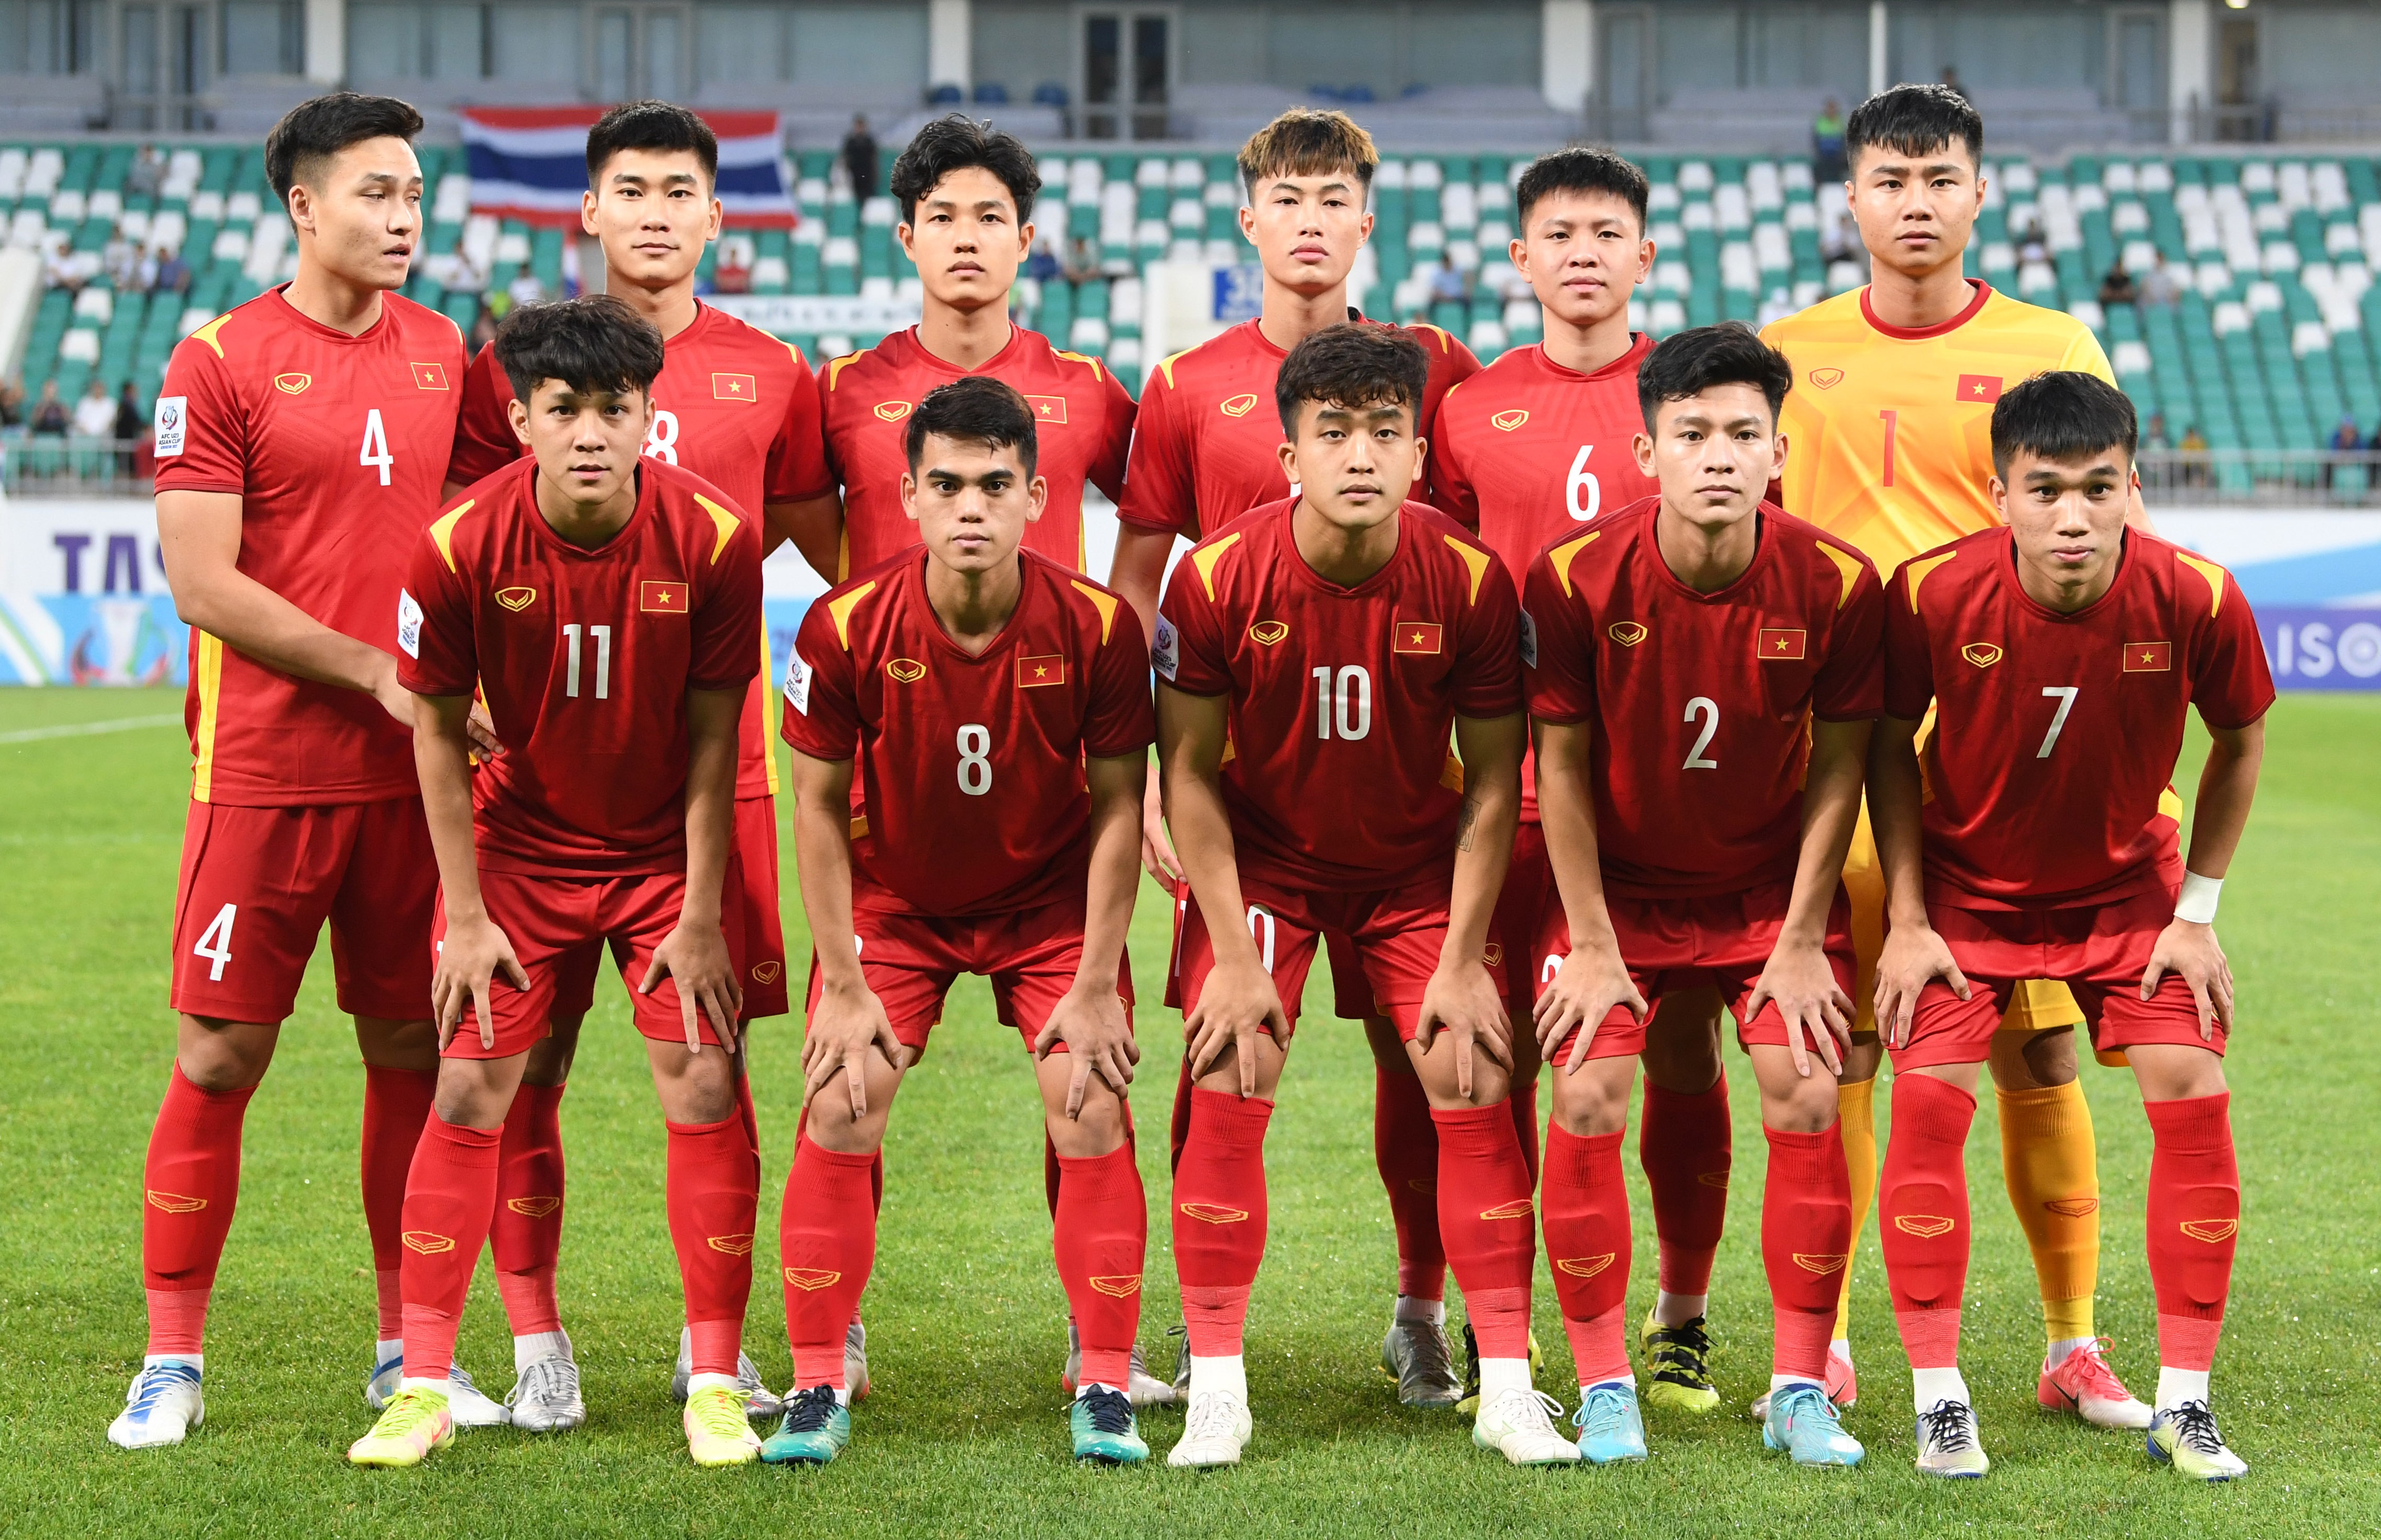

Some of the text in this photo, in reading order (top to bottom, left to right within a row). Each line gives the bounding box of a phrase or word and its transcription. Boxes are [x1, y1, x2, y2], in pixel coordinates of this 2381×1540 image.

[359, 408, 394, 486] 4
[639, 410, 679, 466] 8
[1881, 410, 1896, 487] 1
[1565, 444, 1600, 522] 6
[54, 534, 166, 594] TA
[563, 624, 611, 699] 11
[2266, 623, 2381, 677] ISO
[1312, 664, 1371, 740] 10
[1682, 696, 1719, 769] 2
[2036, 686, 2079, 758] 7
[956, 724, 992, 796] 8
[193, 903, 237, 982] 4
[1246, 903, 1275, 976] 0
